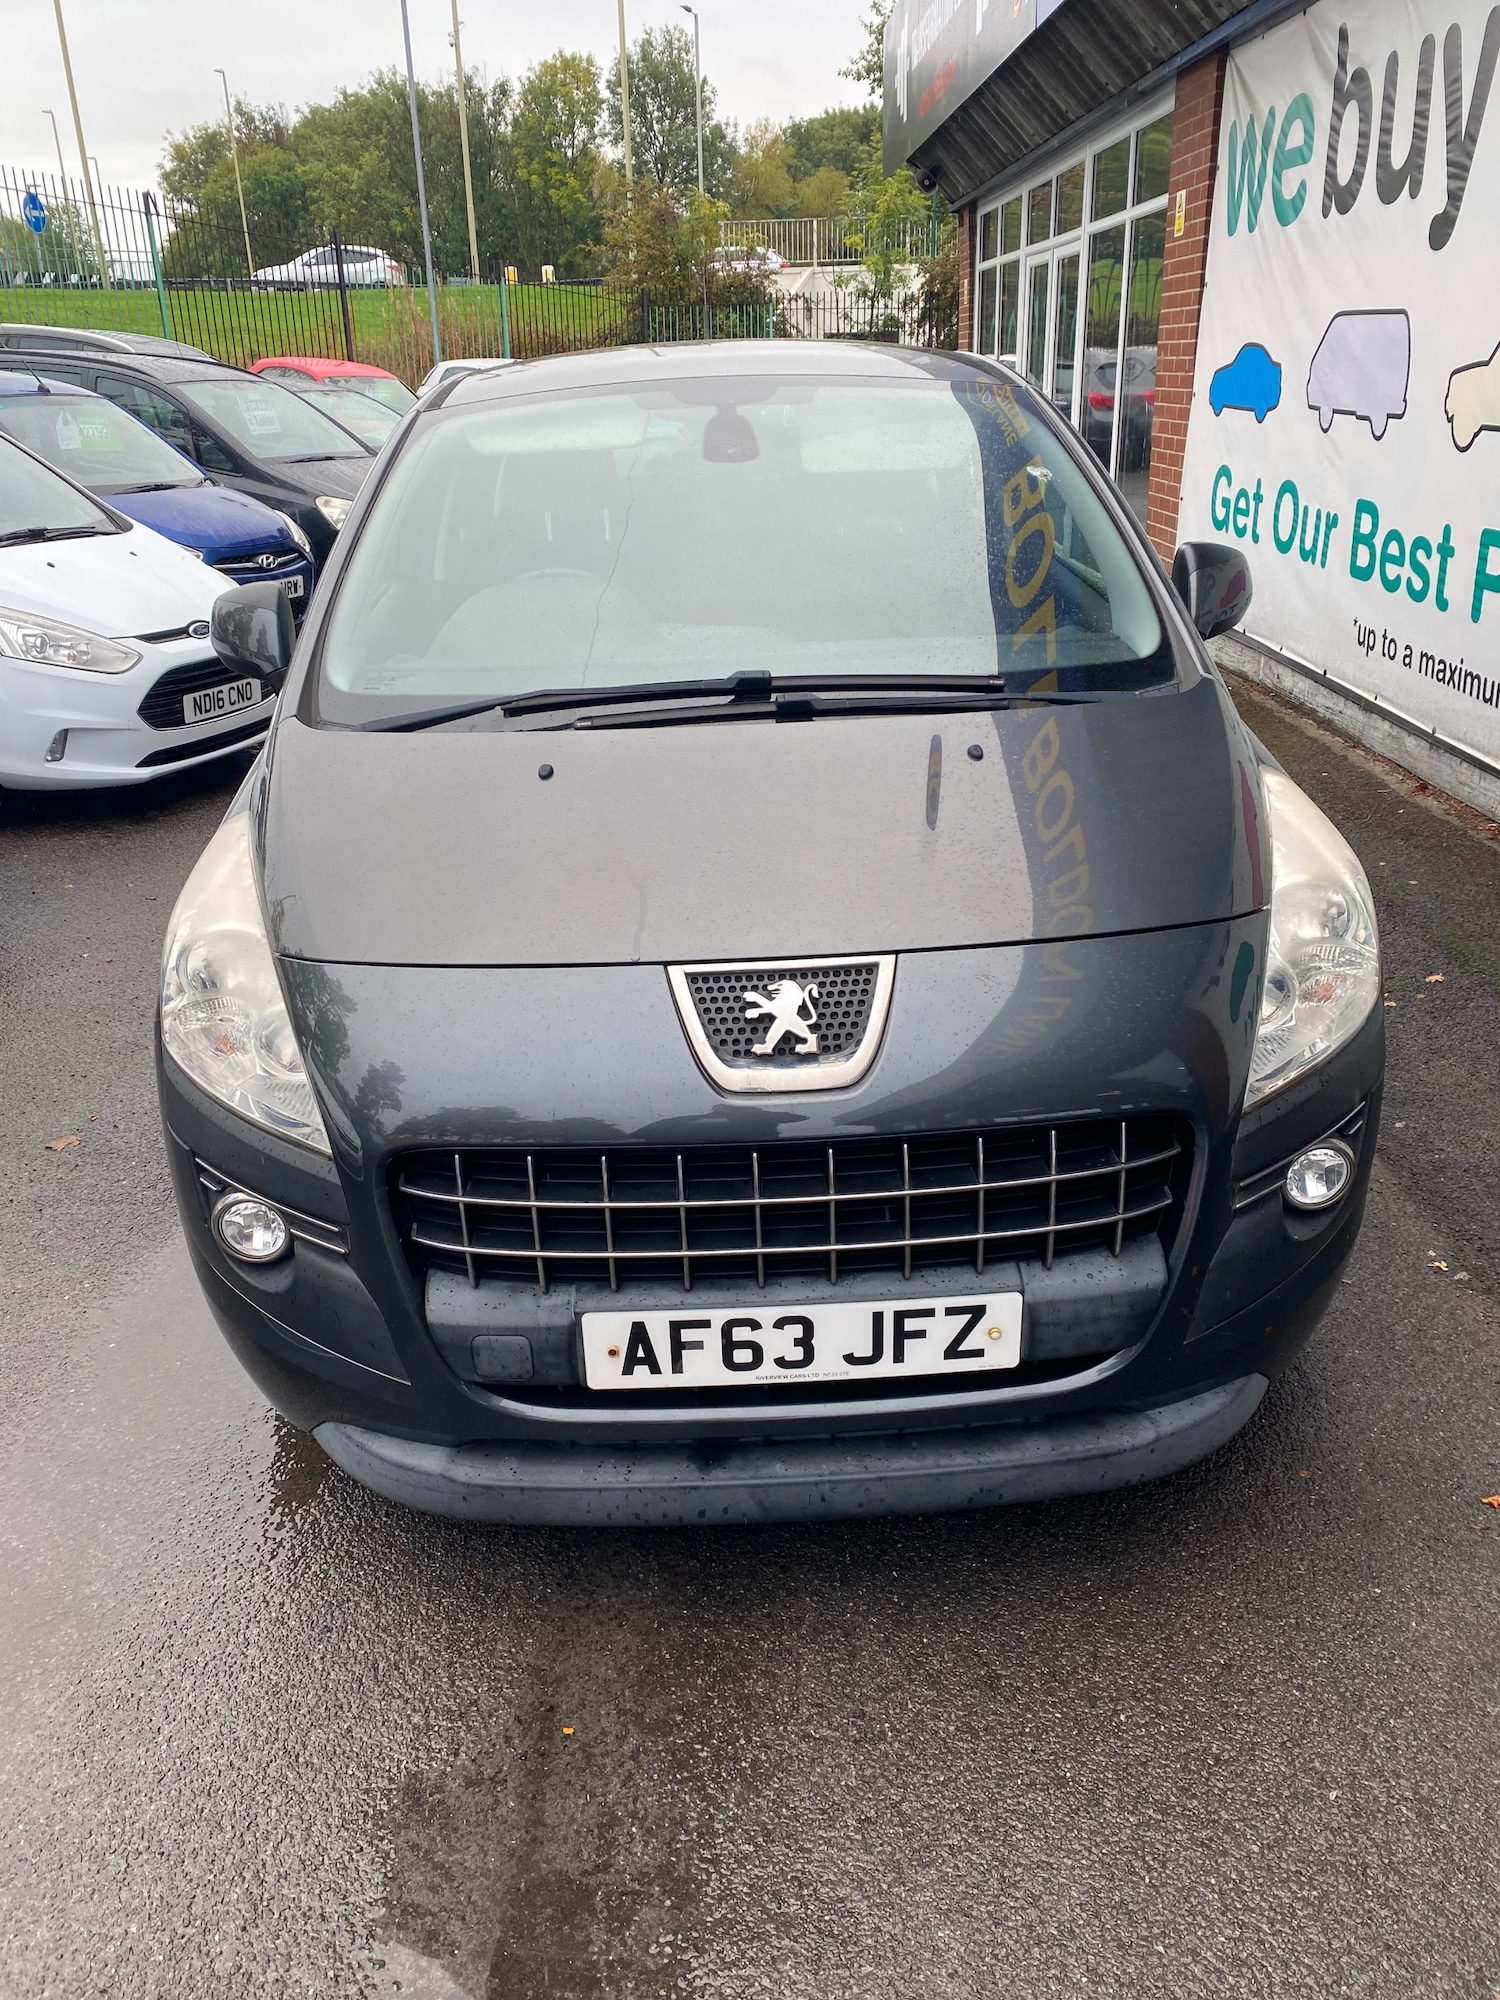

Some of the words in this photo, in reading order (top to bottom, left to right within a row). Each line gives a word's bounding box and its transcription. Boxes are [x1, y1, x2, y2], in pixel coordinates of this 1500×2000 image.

[1227, 92, 1315, 237] we
[1322, 4, 1500, 251] buy
[1211, 464, 1264, 544] Get
[1273, 479, 1338, 568] Our
[1350, 498, 1455, 612] Best
[1382, 628, 1397, 660] to
[1403, 644, 1413, 669] a
[193, 689, 225, 717] ND16
[228, 681, 252, 706] CNO
[621, 1315, 815, 1376] AF63
[842, 1304, 987, 1366] JFZ
